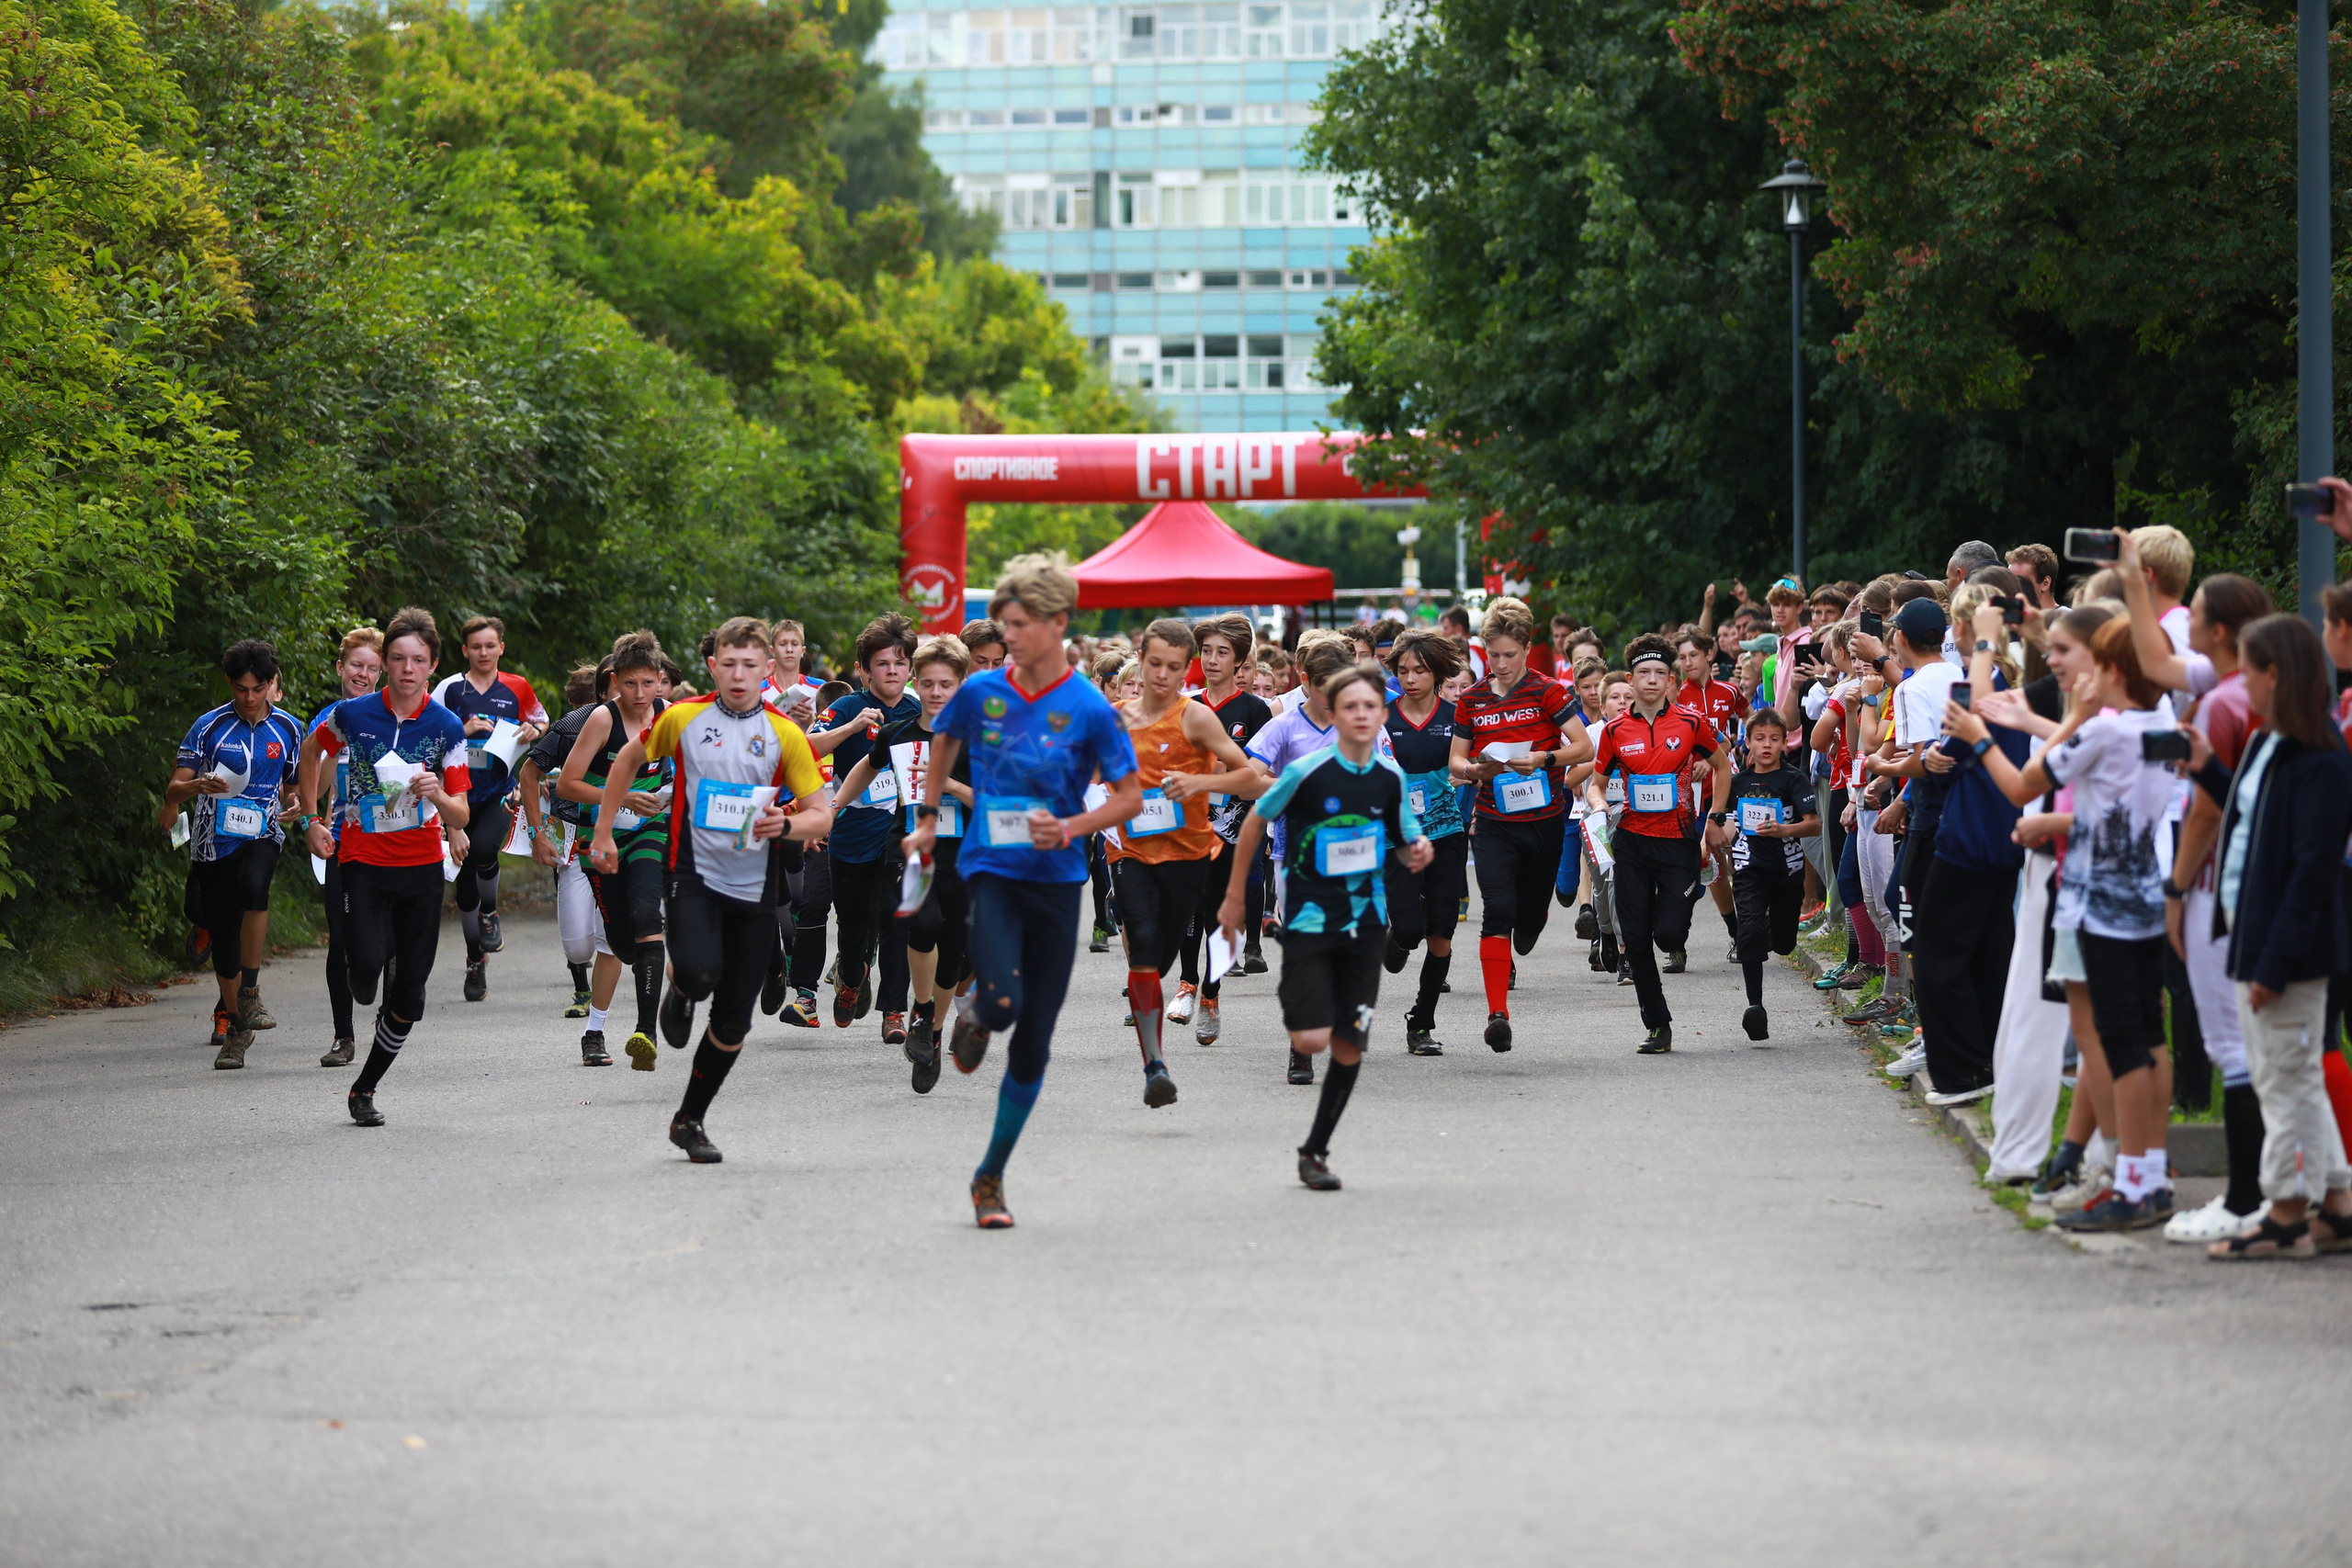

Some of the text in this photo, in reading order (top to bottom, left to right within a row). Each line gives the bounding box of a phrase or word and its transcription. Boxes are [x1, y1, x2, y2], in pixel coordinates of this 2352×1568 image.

[954, 456, 1059, 480] СПОРТИВНОЕ
[1136, 438, 1306, 499] СТАРТ
[1631, 652, 1662, 665] noname
[1503, 706, 1542, 723] WEST
[875, 778, 894, 791] 319.
[1510, 785, 1533, 799] 300.1
[1641, 794, 1665, 802] 321.1
[379, 810, 405, 820] 330.1
[619, 807, 634, 815] 9.1
[716, 802, 746, 815] 310.1
[1142, 806, 1162, 816] 05.1
[1747, 810, 1763, 820] 322.
[229, 813, 253, 824] 340.1
[1782, 805, 1804, 876] RSIA
[1898, 885, 1913, 943] FILA
